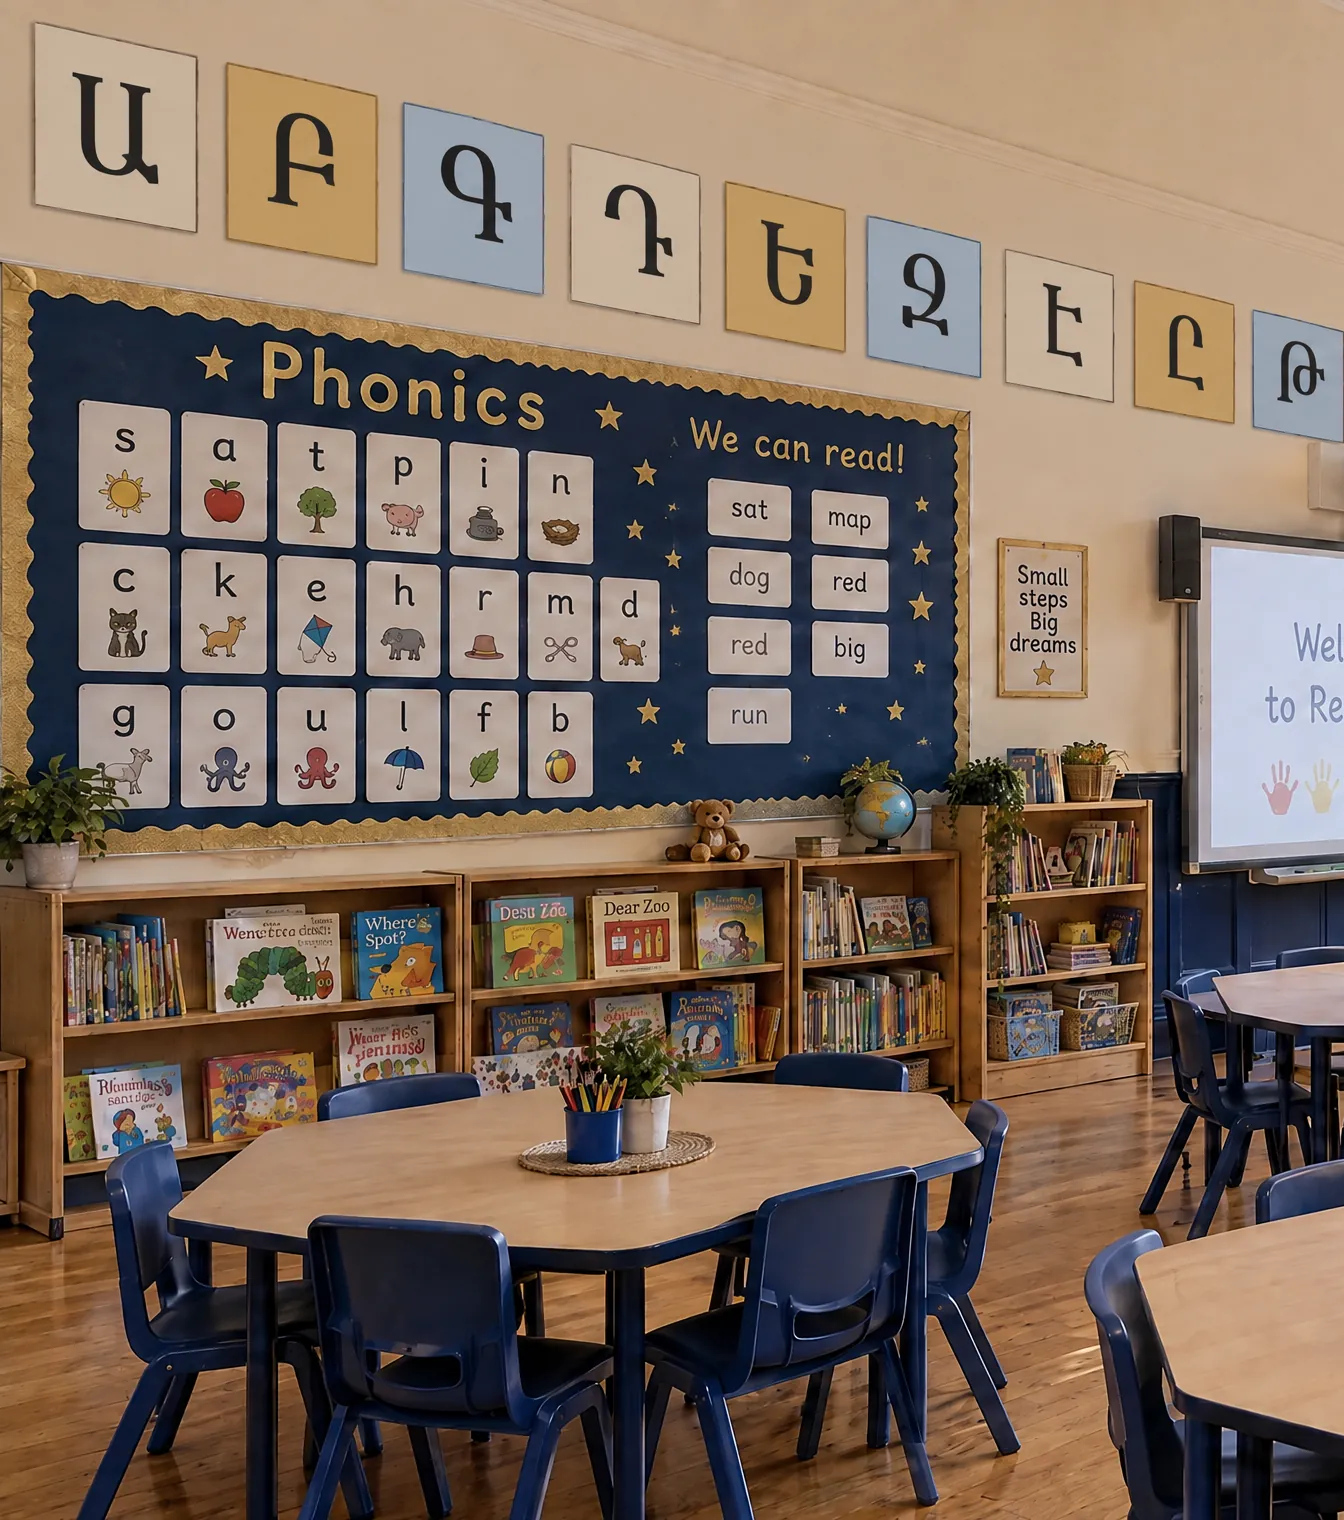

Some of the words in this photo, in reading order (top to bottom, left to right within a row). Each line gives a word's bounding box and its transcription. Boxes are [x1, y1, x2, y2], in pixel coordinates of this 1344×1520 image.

[72, 71, 159, 185] Ա
[267, 112, 336, 207] Բ
[440, 144, 513, 244] Գ
[604, 184, 673, 278] Դ
[760, 219, 814, 306] Ե
[1042, 282, 1083, 368] Է
[1167, 314, 1205, 391] Ը
[262, 340, 546, 431] Phonics
[1276, 340, 1325, 404] Թ
[114, 428, 136, 453] s
[212, 438, 237, 462] a
[689, 416, 739, 453] We
[755, 435, 811, 464] can
[825, 442, 904, 474] read!
[308, 441, 325, 472] t
[394, 455, 413, 486] p
[480, 457, 488, 489] i
[552, 473, 571, 496] n
[731, 499, 768, 520] sat
[828, 510, 871, 536] map
[113, 568, 136, 593] c
[215, 561, 238, 598] k
[307, 579, 327, 602] e
[395, 573, 415, 607] h
[729, 561, 769, 595] dog
[833, 571, 867, 593] red
[1017, 564, 1069, 587] Small
[478, 590, 493, 611] r
[547, 594, 575, 615] m
[621, 589, 639, 618] d
[1019, 589, 1068, 613] steps
[1030, 610, 1058, 637] Big
[731, 632, 768, 656] red
[834, 634, 865, 665] big
[1009, 632, 1077, 654] dreams
[213, 708, 236, 731] o
[476, 701, 493, 733] f
[552, 702, 569, 733] b
[732, 709, 768, 725] run
[1264, 685, 1296, 724] to
[112, 705, 135, 738] g
[306, 709, 328, 732] u
[603, 901, 640, 917] Dear
[643, 898, 670, 914] Zoo
[365, 930, 407, 950] Spot?
